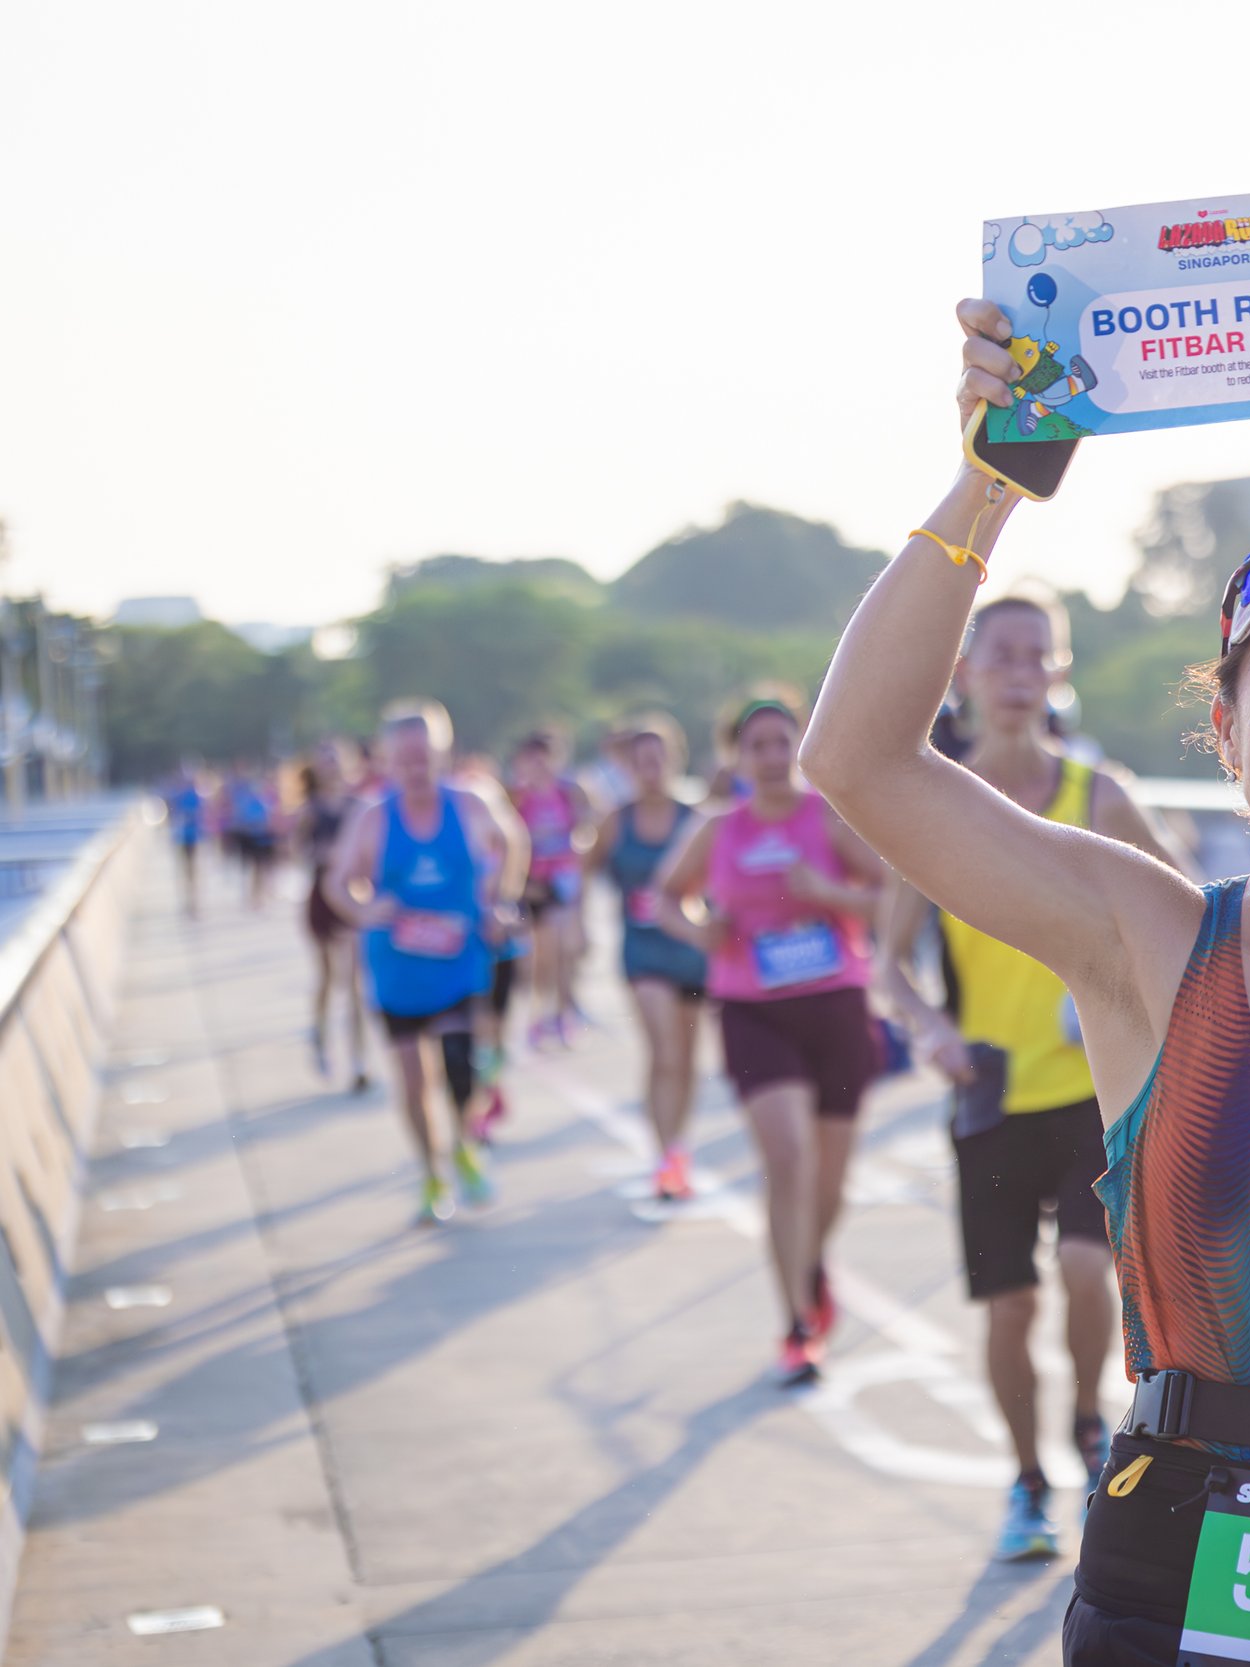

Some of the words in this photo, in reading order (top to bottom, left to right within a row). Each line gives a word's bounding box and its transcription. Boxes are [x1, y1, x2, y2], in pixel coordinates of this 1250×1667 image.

[1092, 299, 1219, 336] BOOTH
[1141, 331, 1245, 361] FITBAR
[1139, 368, 1158, 380] Visit
[1159, 367, 1174, 378] the
[1175, 364, 1199, 376] Fitbar
[1201, 362, 1226, 374] booth
[1227, 361, 1237, 371] at
[1226, 376, 1236, 386] to
